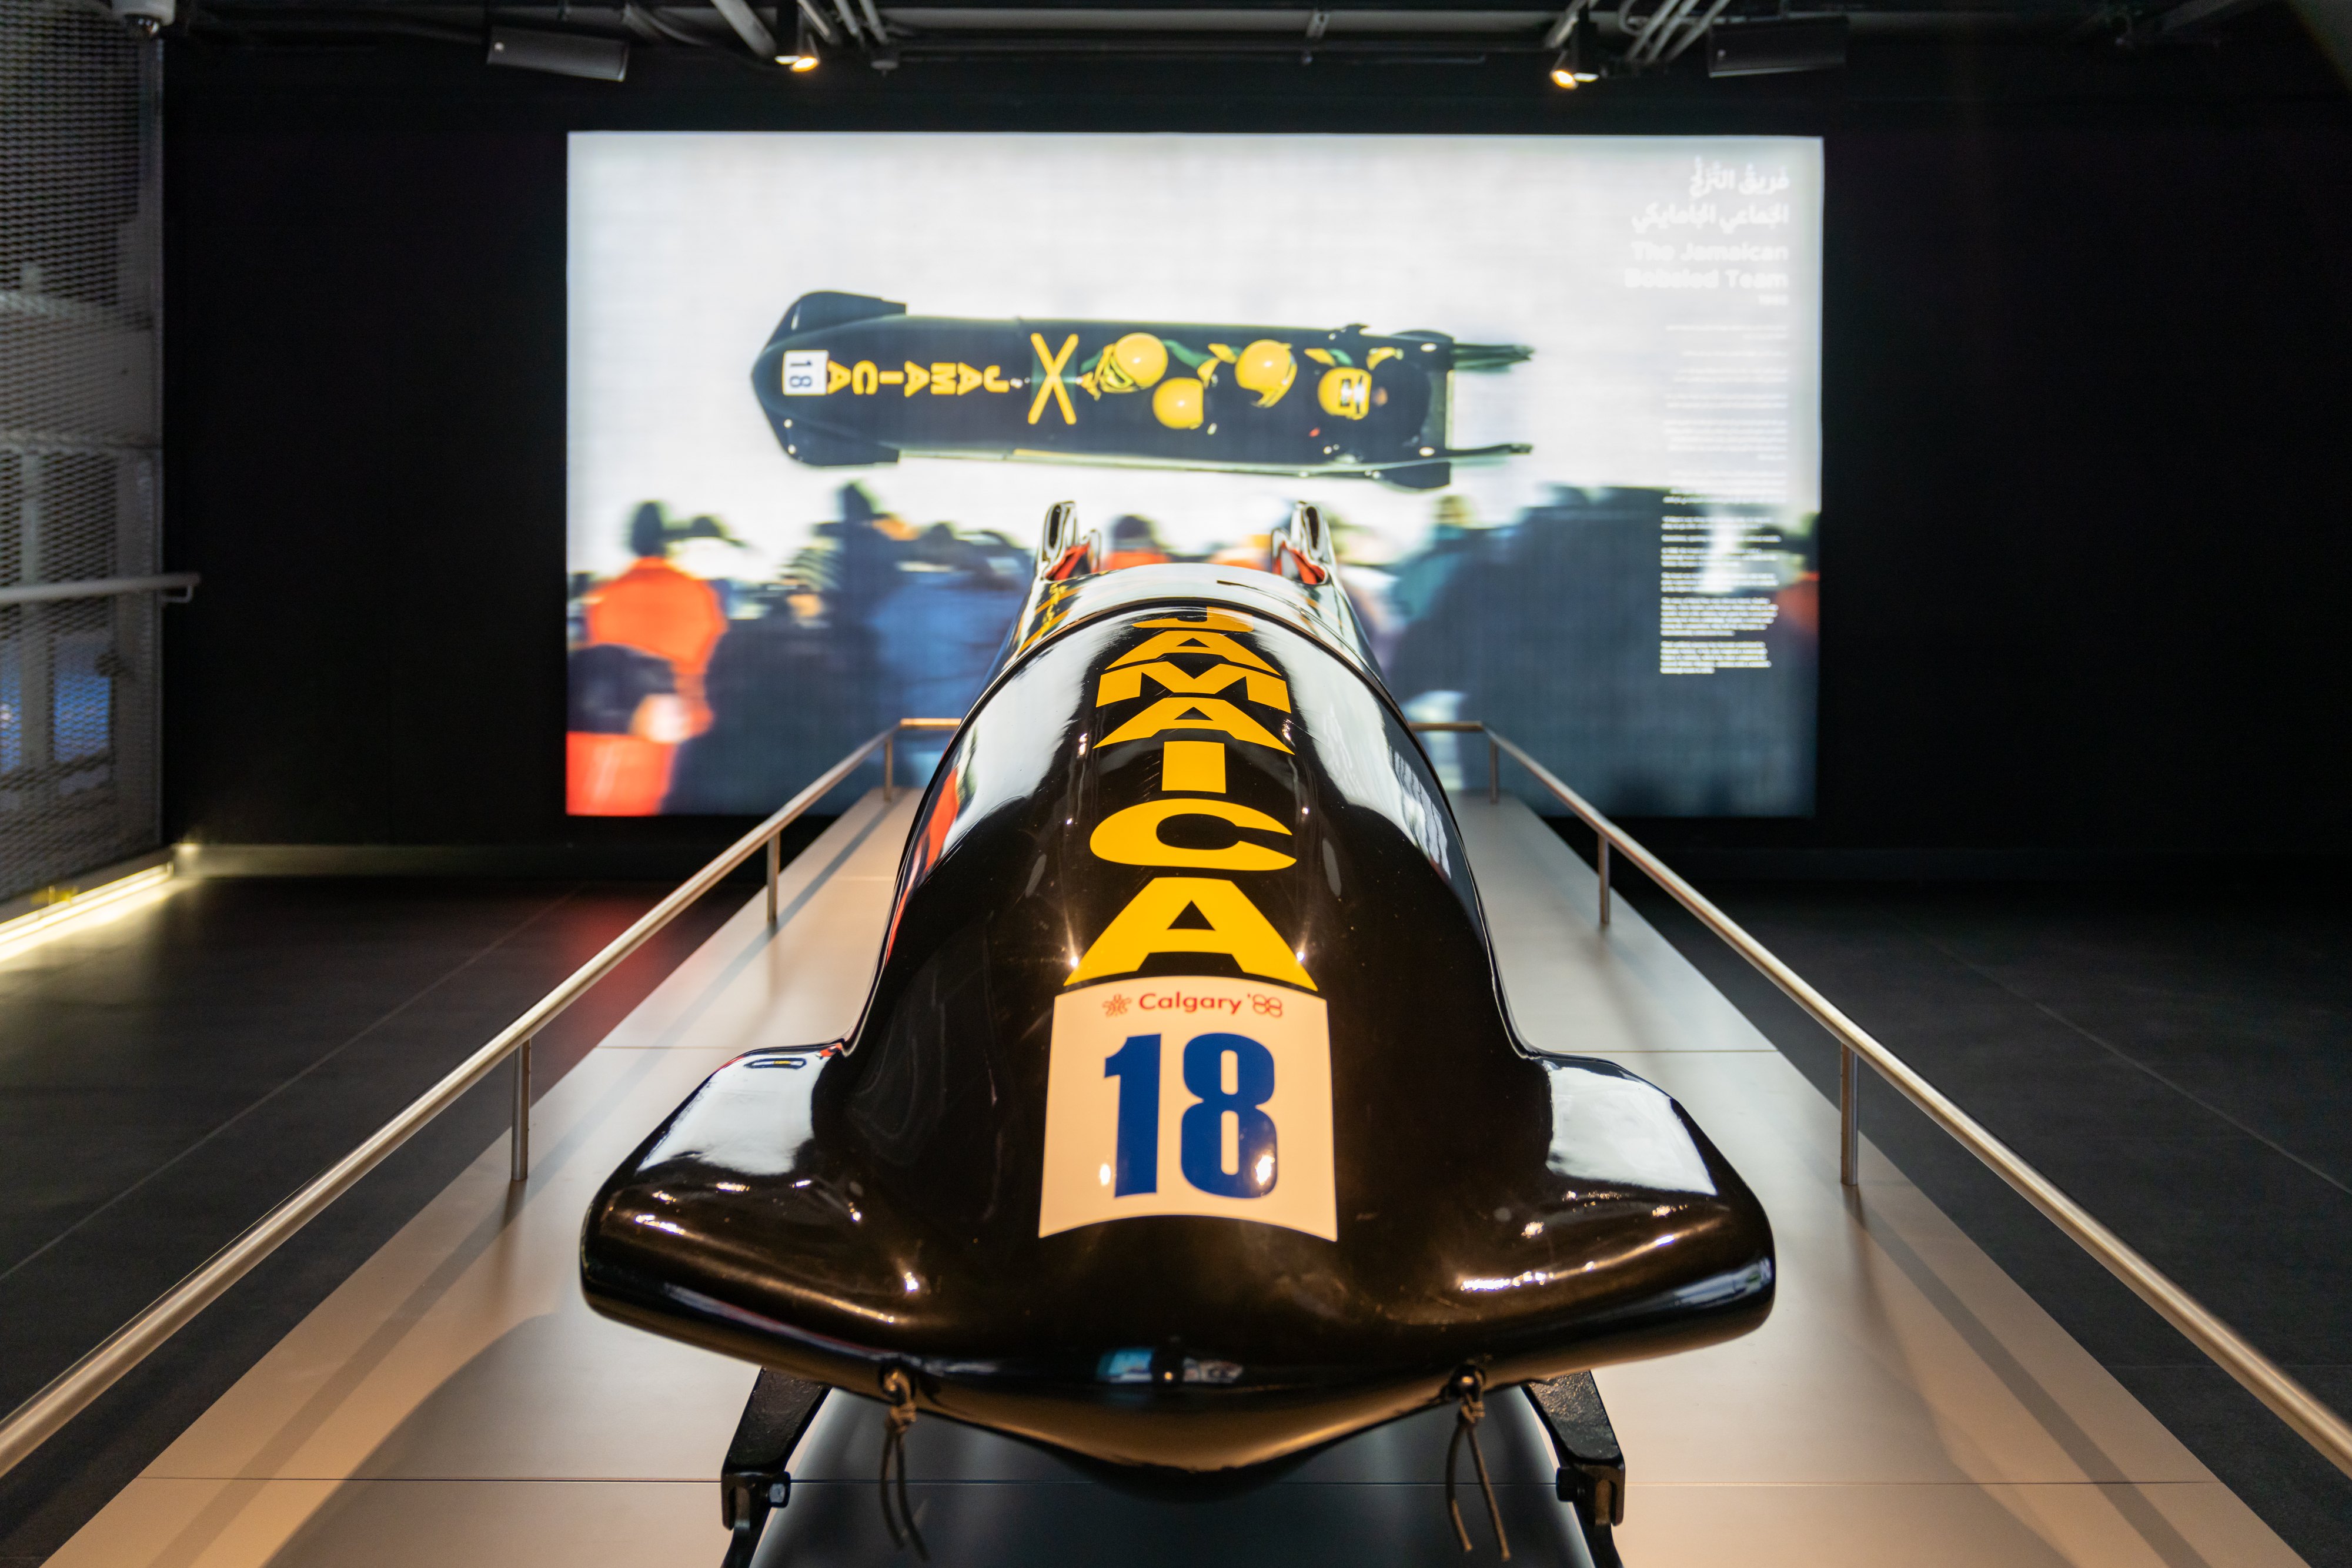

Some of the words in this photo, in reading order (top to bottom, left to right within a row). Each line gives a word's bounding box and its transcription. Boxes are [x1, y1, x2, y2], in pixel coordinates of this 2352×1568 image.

[1631, 240, 1675, 261] The
[1680, 240, 1789, 262] Jamaican
[1724, 269, 1789, 288] Team
[790, 360, 813, 388] 18
[827, 360, 1010, 397] JAMAICA
[1063, 606, 1318, 992] JAMAICA
[1139, 991, 1242, 1015] Calgary
[1104, 1032, 1277, 1200] 18
